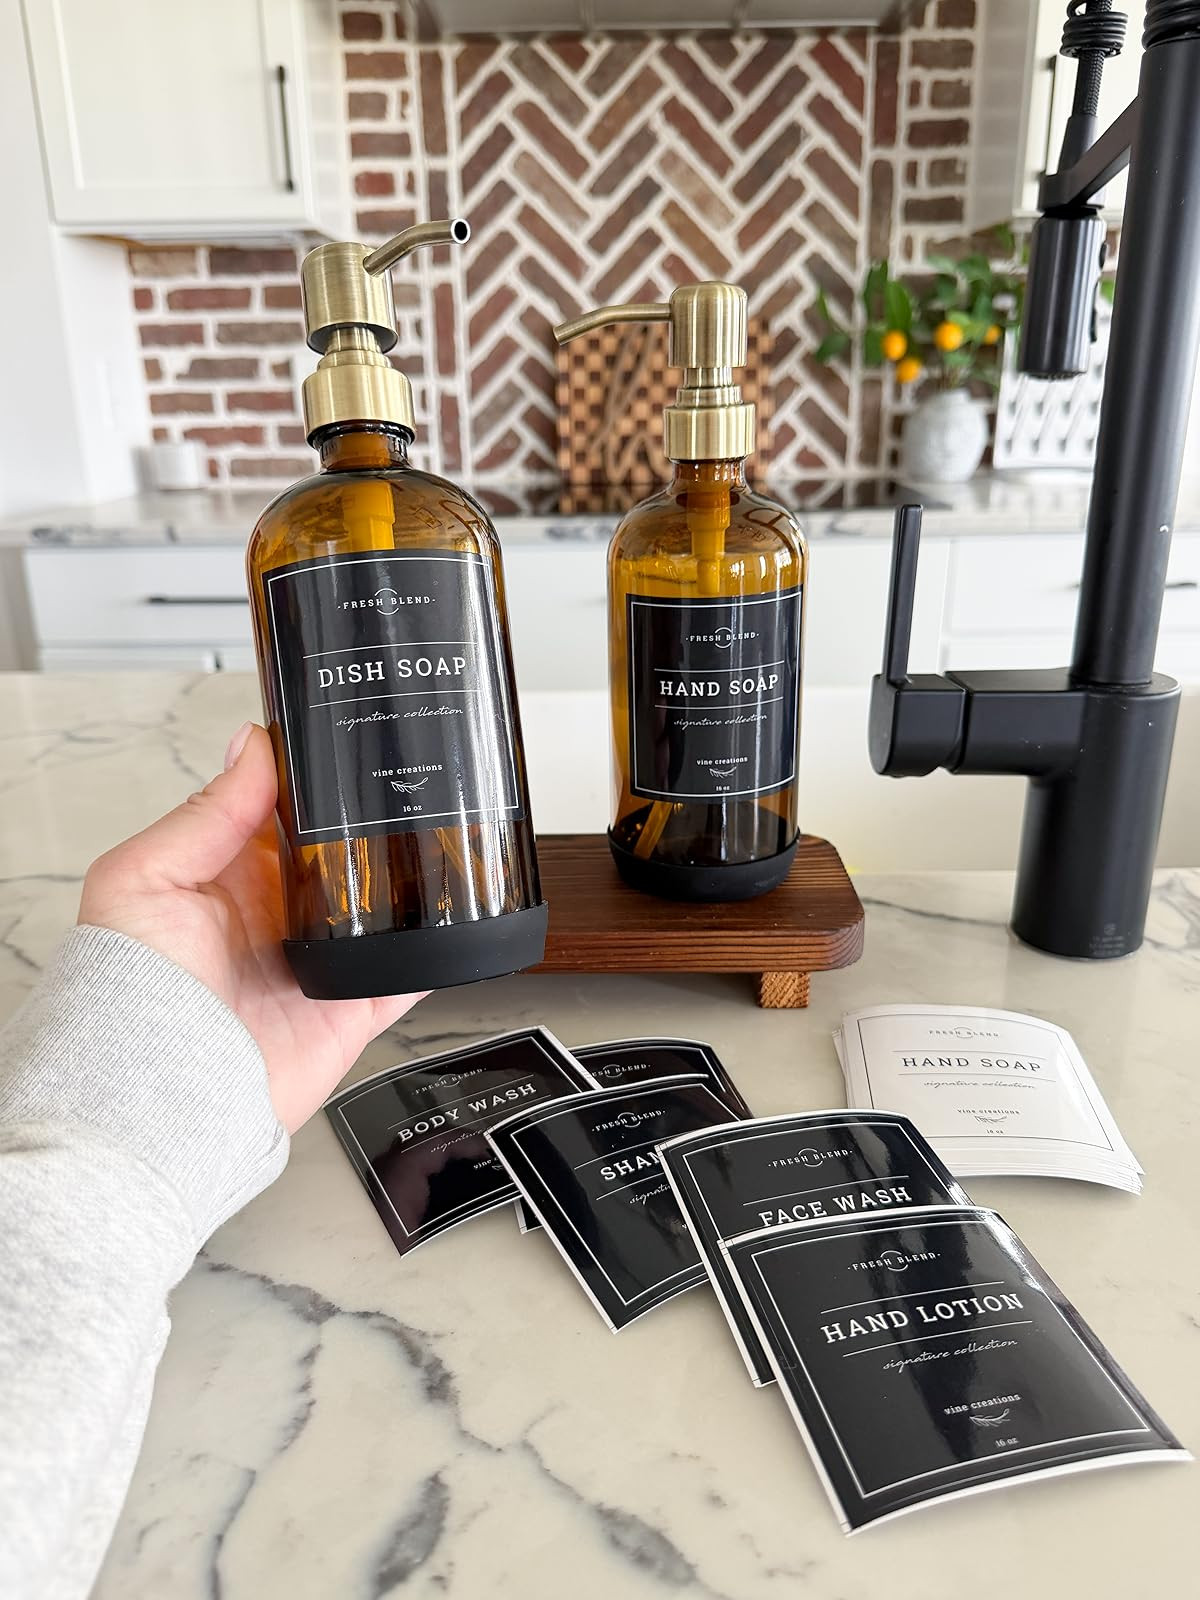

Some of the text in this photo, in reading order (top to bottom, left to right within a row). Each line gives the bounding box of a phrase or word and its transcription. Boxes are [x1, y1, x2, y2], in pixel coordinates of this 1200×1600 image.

[317, 656, 468, 689] DISH SOAP
[659, 673, 779, 697] HAND SOAP
[336, 705, 464, 732] signature collection
[673, 713, 768, 731] signature collection
[372, 762, 443, 778] vine creations
[714, 756, 748, 765] creations
[402, 804, 423, 813] 16 oz
[902, 1056, 1042, 1074] HAND SOAP
[397, 1082, 537, 1144] BODY WASH
[758, 1186, 913, 1228] FACE WASH
[820, 1292, 1025, 1344] HAND LOTION
[882, 1337, 1019, 1374] signature collection
[943, 1392, 1022, 1416] vine creations
[995, 1437, 1007, 1449] 16
